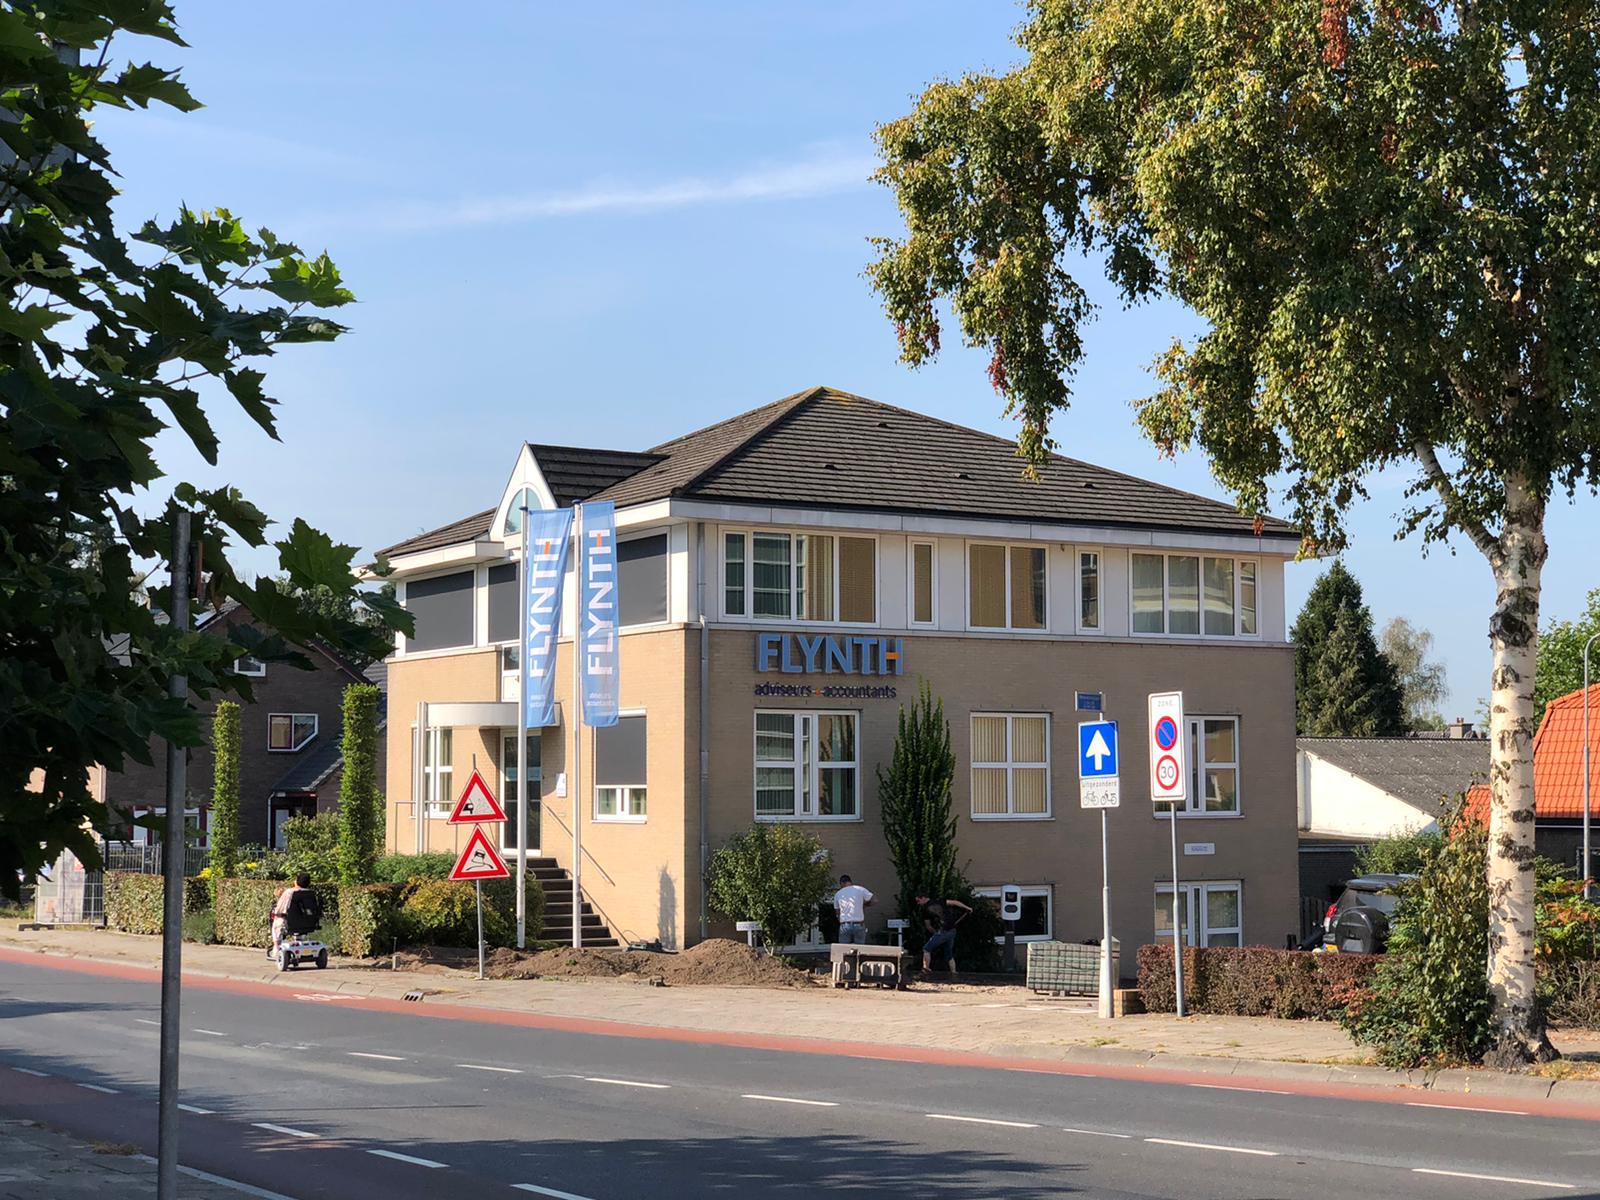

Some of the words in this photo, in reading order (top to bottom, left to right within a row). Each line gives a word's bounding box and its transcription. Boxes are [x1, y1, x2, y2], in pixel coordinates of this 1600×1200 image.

[529, 536, 562, 678] FLYNTH
[587, 529, 614, 676] FLYNTH
[757, 633, 904, 676] FLYNTH
[754, 682, 812, 697] adviseurs
[823, 684, 897, 699] accountants
[1160, 766, 1175, 779] 30
